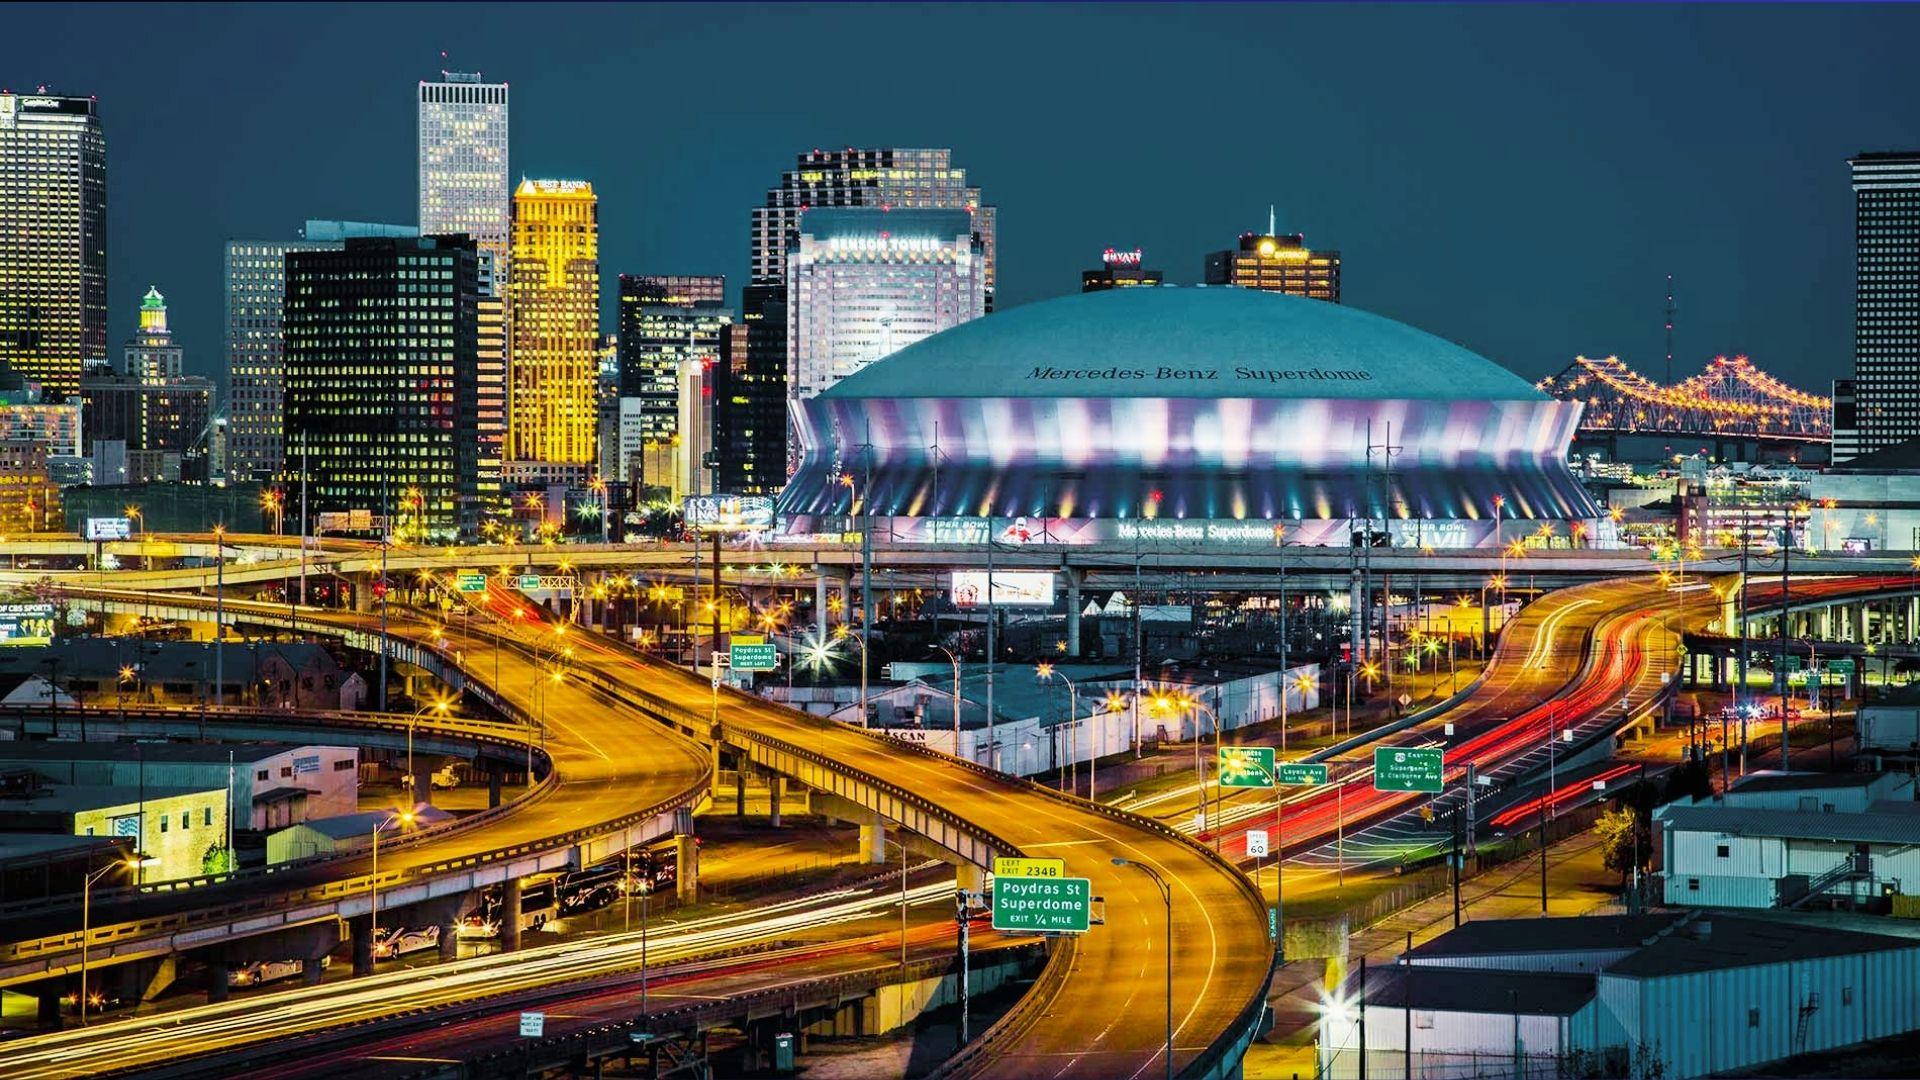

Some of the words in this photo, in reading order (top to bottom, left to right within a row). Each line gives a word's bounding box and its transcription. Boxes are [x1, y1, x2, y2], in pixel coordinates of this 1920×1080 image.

[561, 180, 587, 190] BANK
[831, 238, 888, 252] BENSON
[889, 238, 940, 252] TOWER
[1110, 252, 1141, 263] HYATT
[1025, 366, 1218, 380] Mercedes-Benz
[1234, 367, 1373, 383] Superdome
[1208, 524, 1274, 541] Superdome
[25, 604, 53, 612] SPORTS
[1250, 845, 1264, 854] 60
[1026, 867, 1057, 876] 234B
[1003, 883, 1060, 896] Poydras
[1066, 884, 1080, 895] St
[1001, 898, 1082, 911] Superdome
[1010, 915, 1029, 923] EXIT
[1051, 916, 1073, 924] MILE
